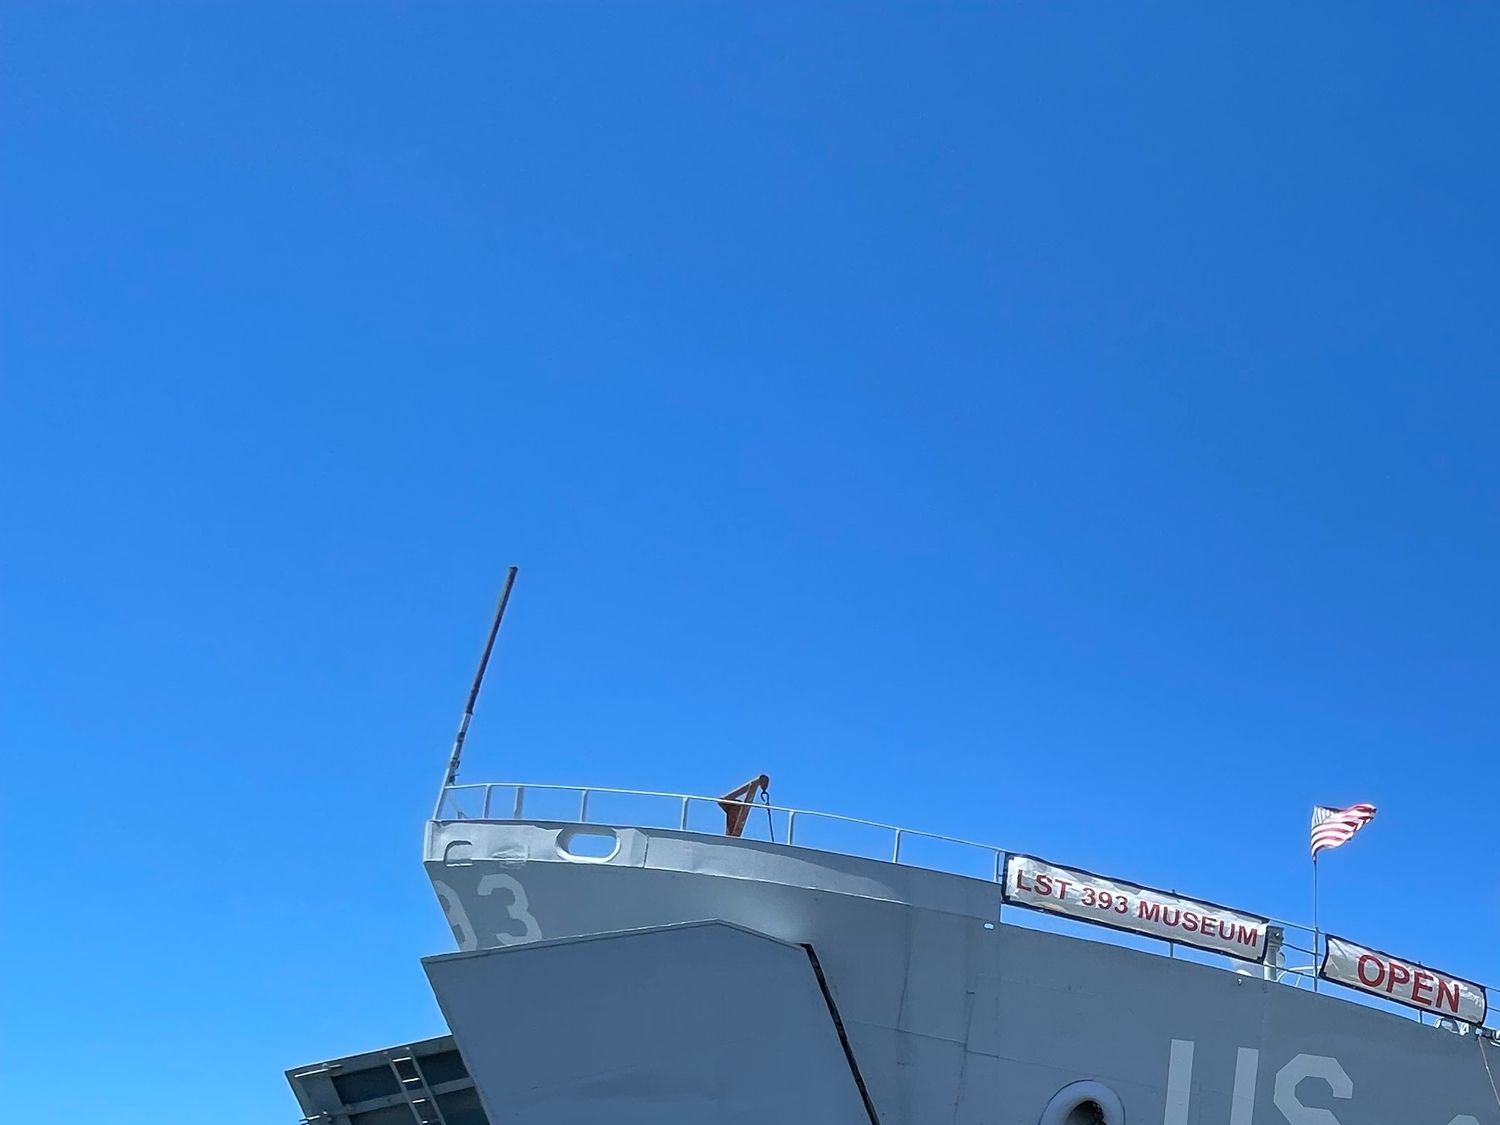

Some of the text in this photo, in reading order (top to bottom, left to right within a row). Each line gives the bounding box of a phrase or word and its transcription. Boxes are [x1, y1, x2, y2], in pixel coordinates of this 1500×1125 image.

[1015, 869, 1259, 947] LST 393 MUSEUM
[1357, 954, 1460, 1013] OPEN
